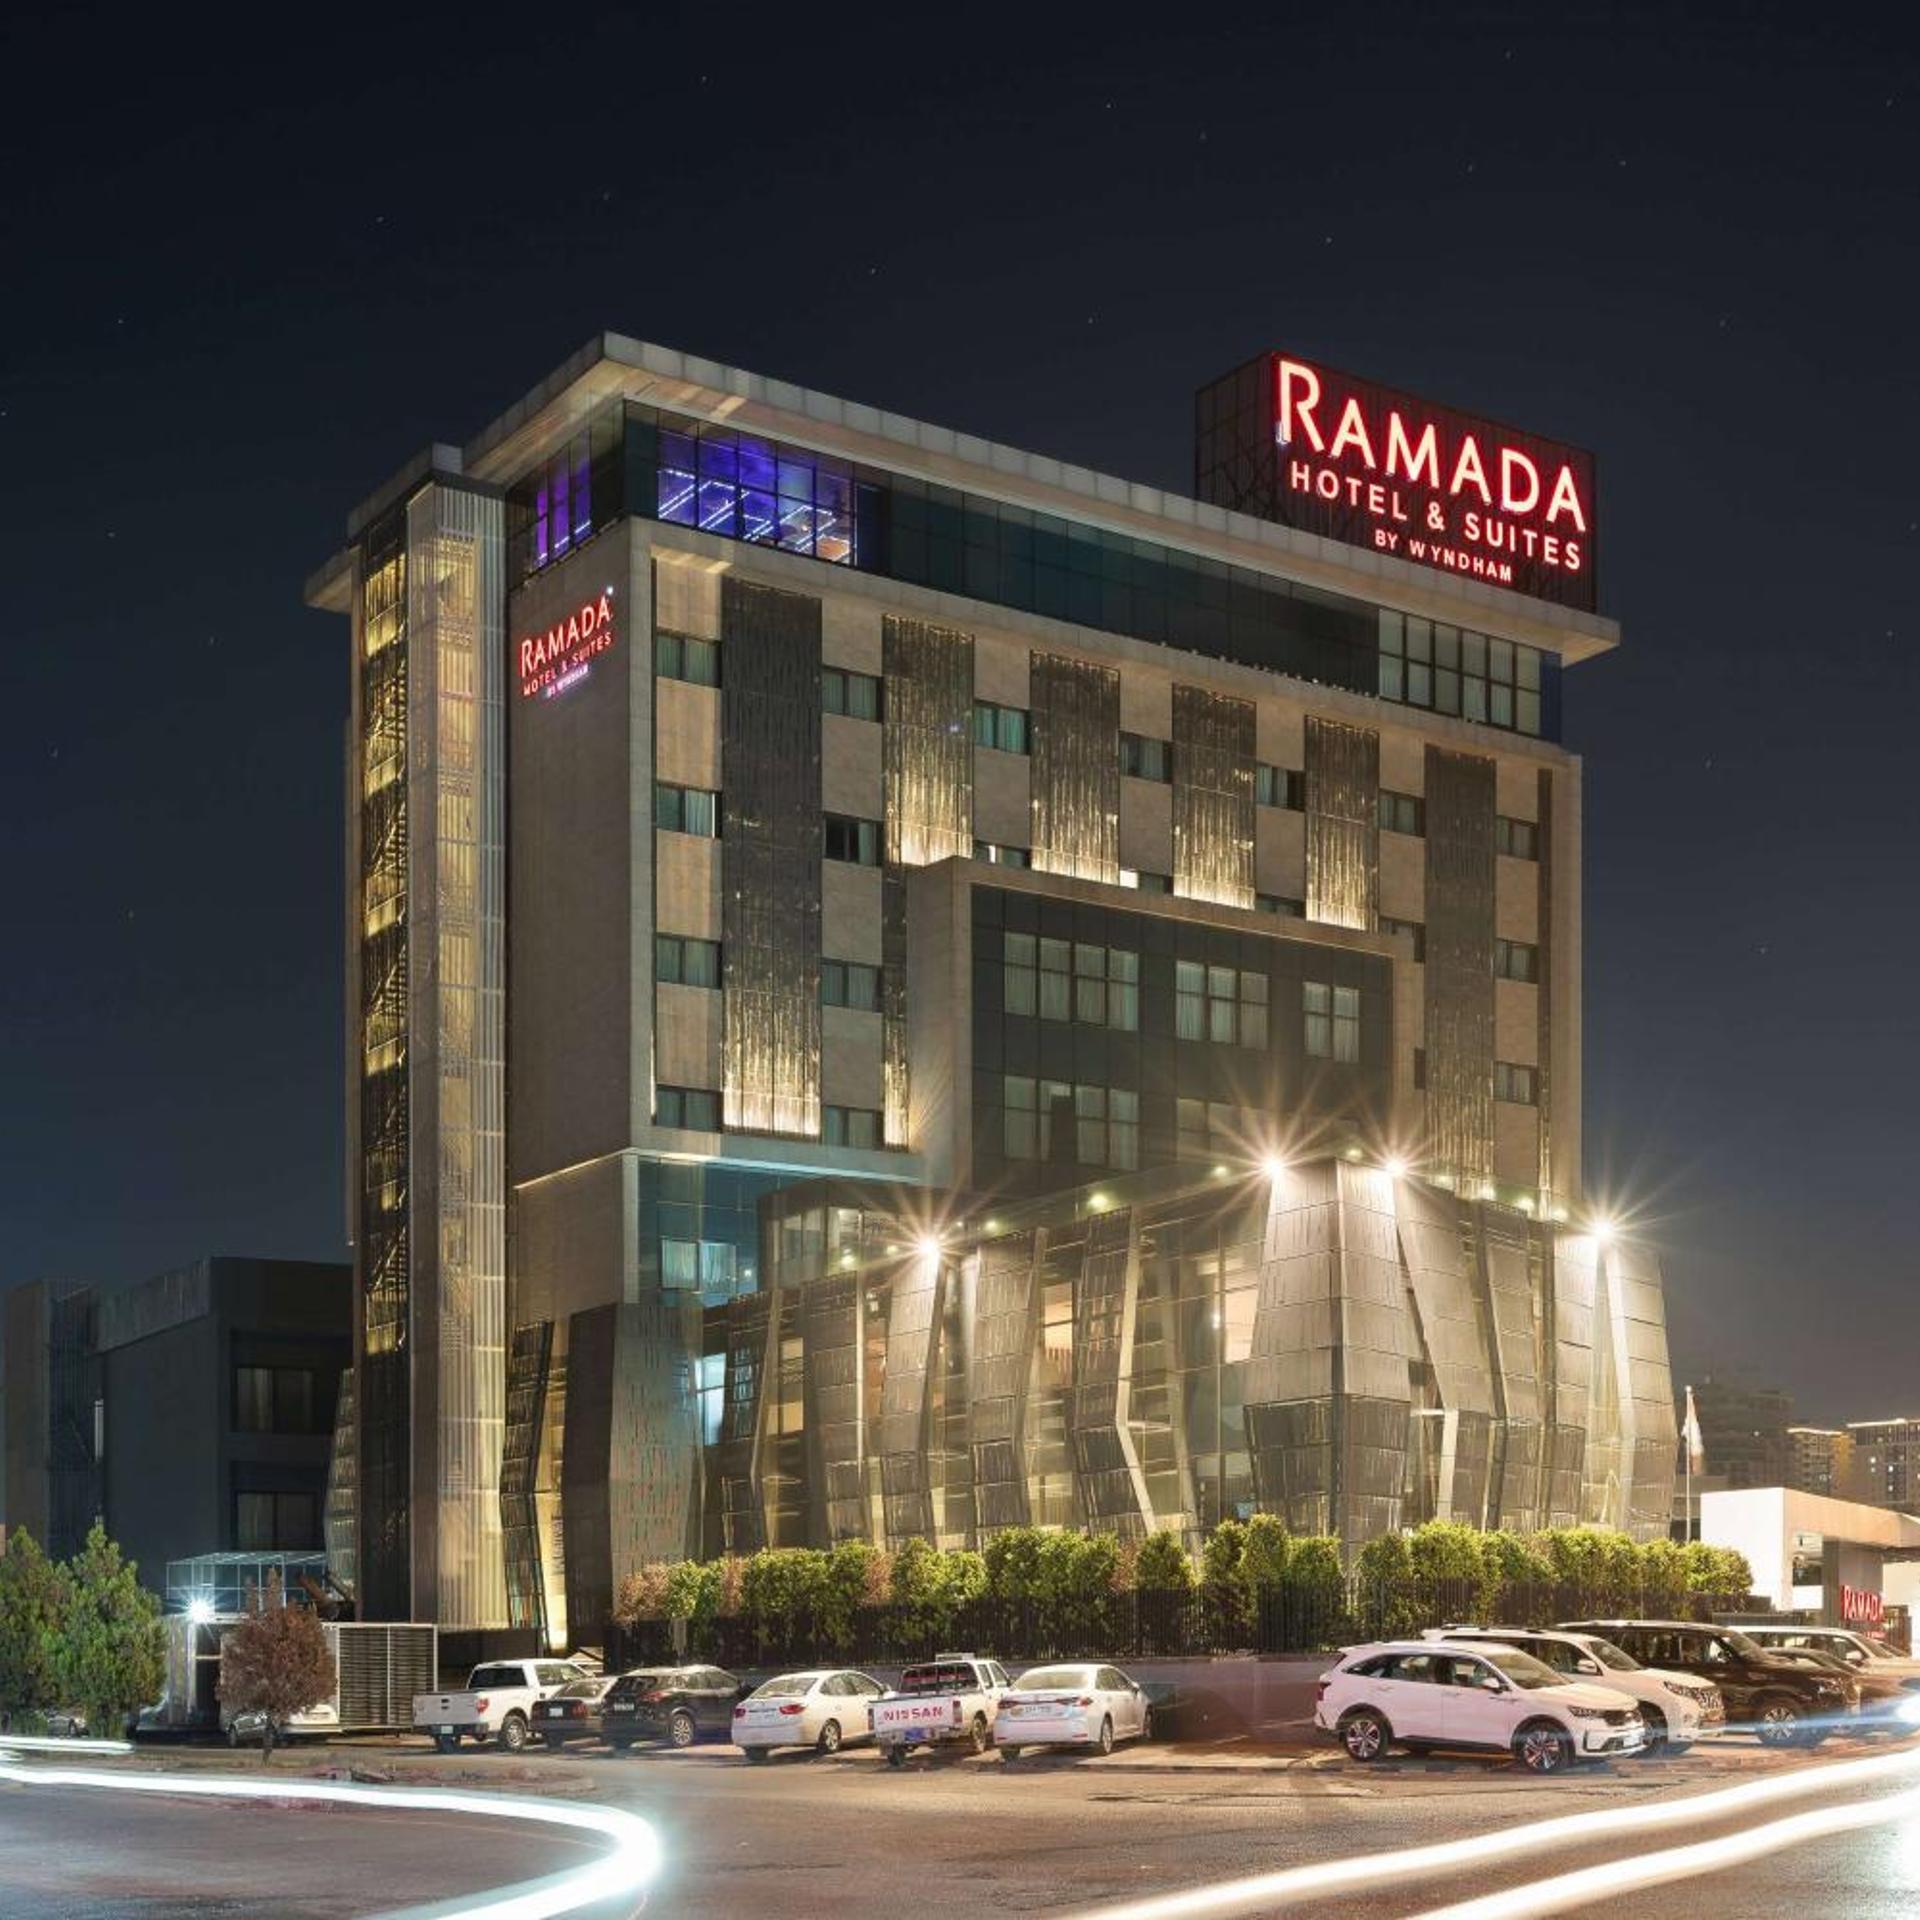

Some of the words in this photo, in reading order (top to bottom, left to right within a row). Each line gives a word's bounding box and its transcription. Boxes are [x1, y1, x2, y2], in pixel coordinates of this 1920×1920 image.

[1279, 359, 1587, 532] RAMADA
[1290, 460, 1408, 522] HOTEL
[1427, 502, 1446, 532] &
[1464, 512, 1581, 571] SUITES
[1374, 529, 1399, 551] BY
[1408, 540, 1512, 583] WYNDHAM
[521, 594, 612, 678] RAMADA
[883, 1706, 943, 1721] NISSAN
